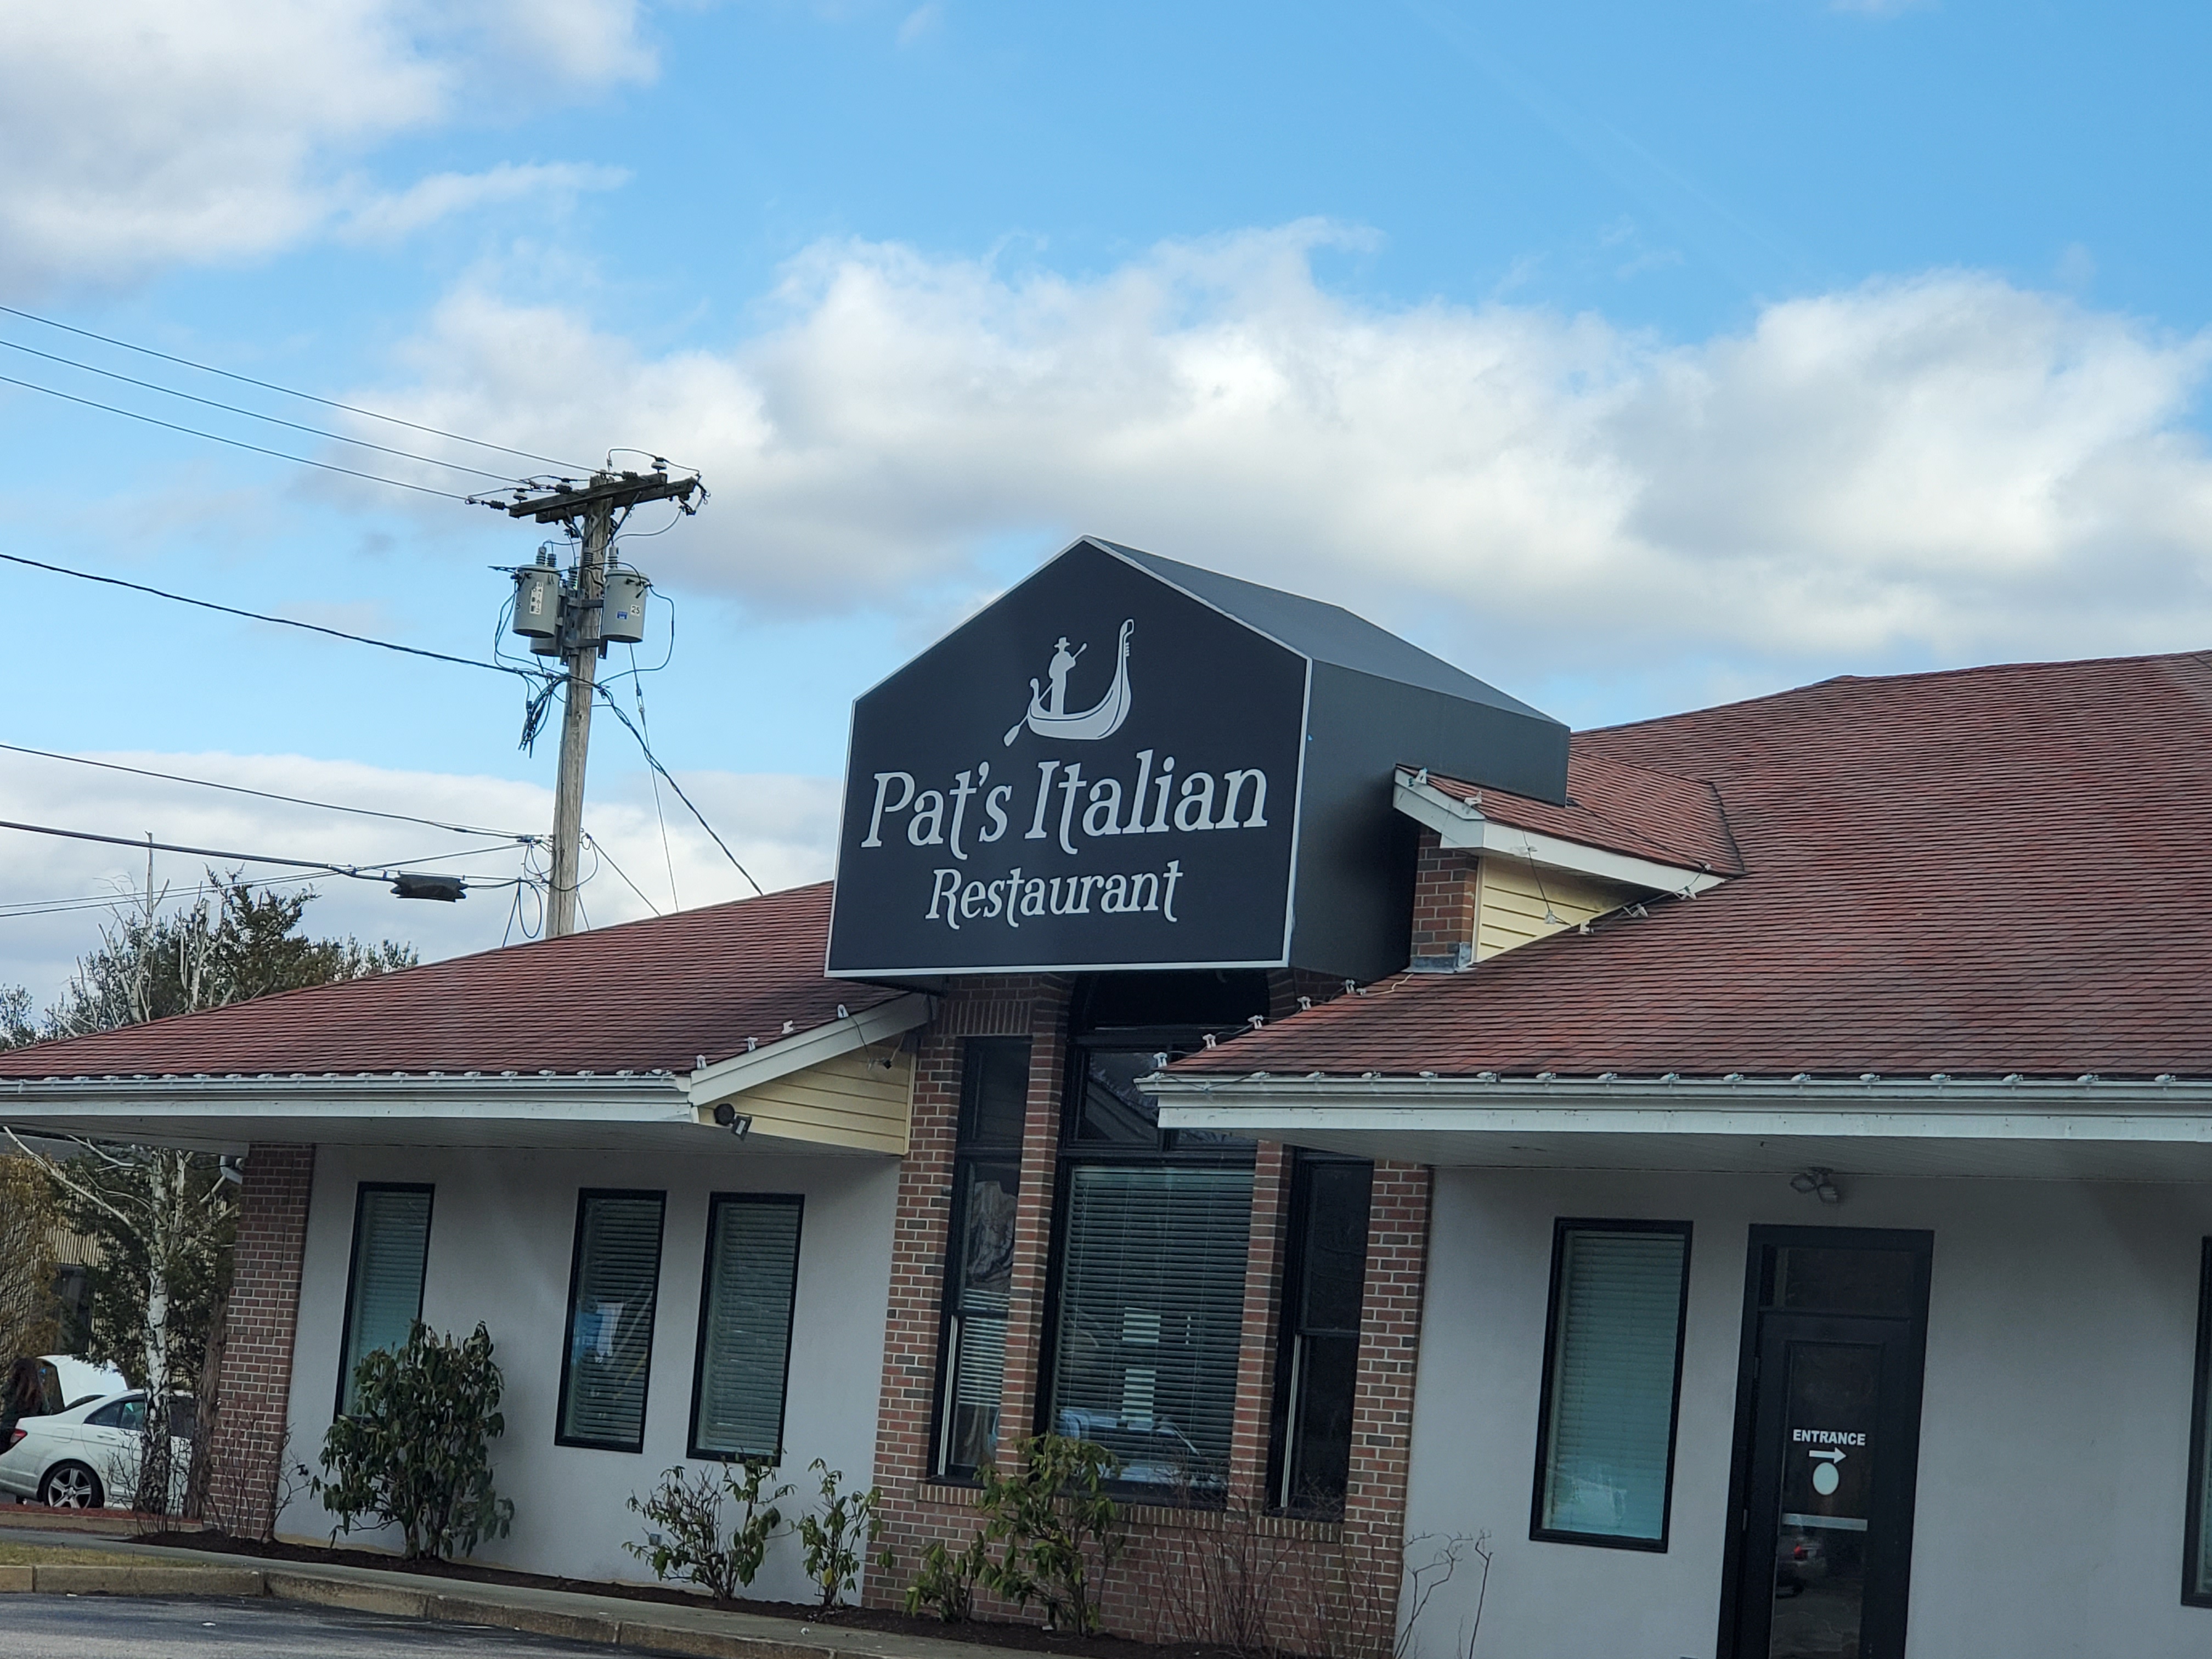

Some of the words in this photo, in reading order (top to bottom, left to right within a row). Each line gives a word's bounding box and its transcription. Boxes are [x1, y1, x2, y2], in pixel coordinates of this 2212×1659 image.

[631, 606, 640, 614] 25
[861, 761, 1013, 860] Pat's
[1024, 749, 1268, 855] Italian
[925, 860, 1183, 930] Restaurant
[1793, 1429, 1866, 1446] ENTRANCE
